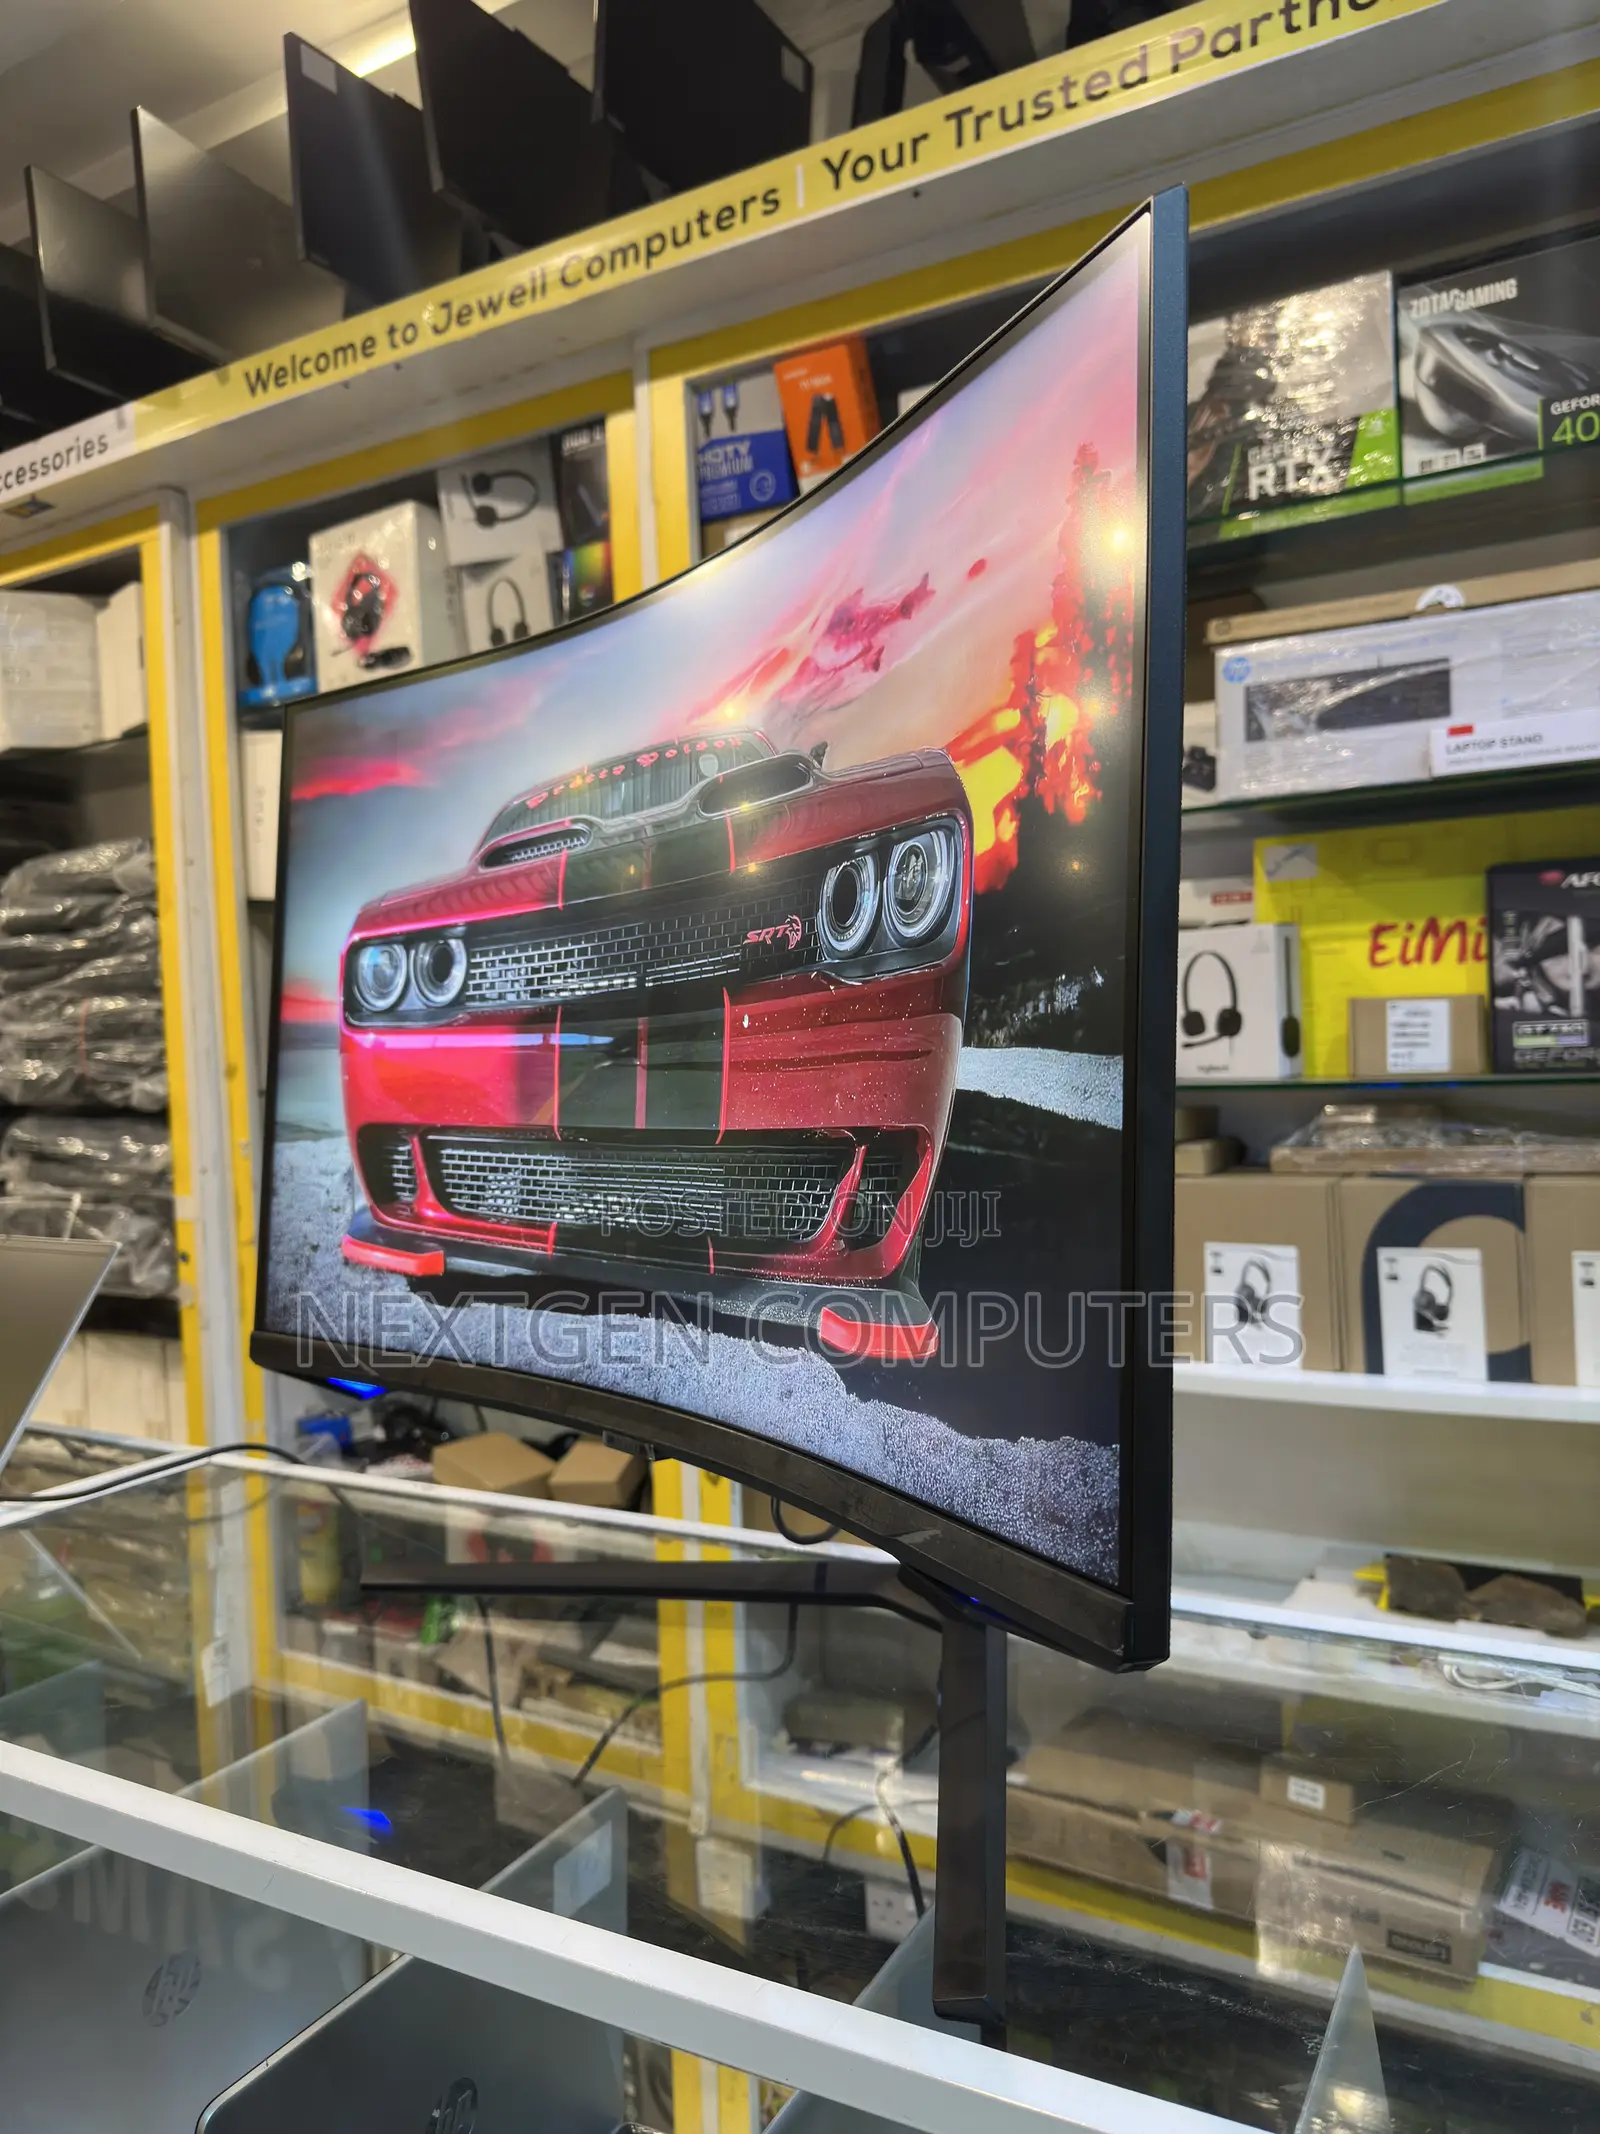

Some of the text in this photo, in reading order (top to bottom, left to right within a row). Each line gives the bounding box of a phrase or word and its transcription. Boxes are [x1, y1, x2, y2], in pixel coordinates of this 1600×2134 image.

[821, 132, 930, 191] Your
[945, 44, 1148, 149] Trusted
[244, 186, 781, 398] Welcome to Jewell Computers
[0, 433, 109, 493] cessories
[1447, 739, 1496, 755] LAPTOP
[1499, 733, 1543, 749] STAND
[743, 924, 791, 945] SRT
